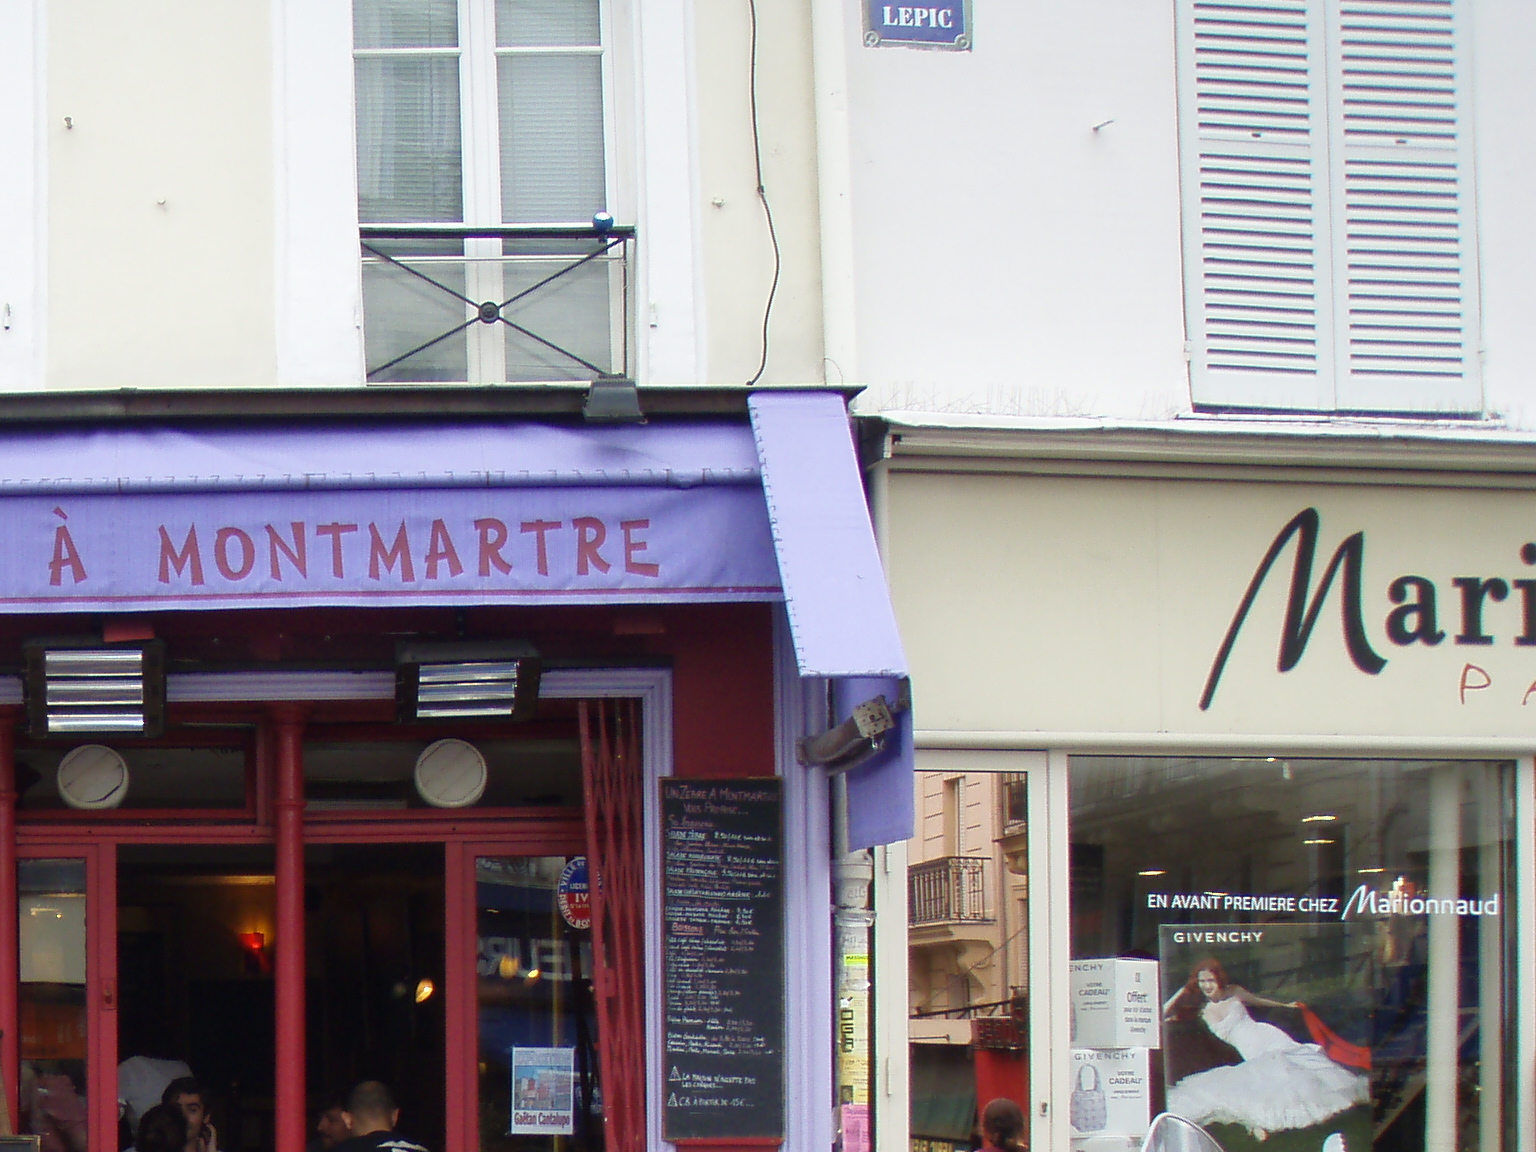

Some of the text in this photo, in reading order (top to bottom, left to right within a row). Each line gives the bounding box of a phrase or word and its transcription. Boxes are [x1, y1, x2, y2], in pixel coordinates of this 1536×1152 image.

[882, 6, 953, 29] LEPIC
[48, 506, 87, 587] À
[157, 515, 660, 587] MONTMARTRE
[575, 893, 589, 903] IV
[1147, 885, 1499, 921] EN AVANT PREMIERE CHEZ Marionnaud
[1173, 931, 1263, 944] GIVENCHY
[1070, 964, 1104, 973] ENCHY
[1074, 1052, 1136, 1061] GIVENCHY
